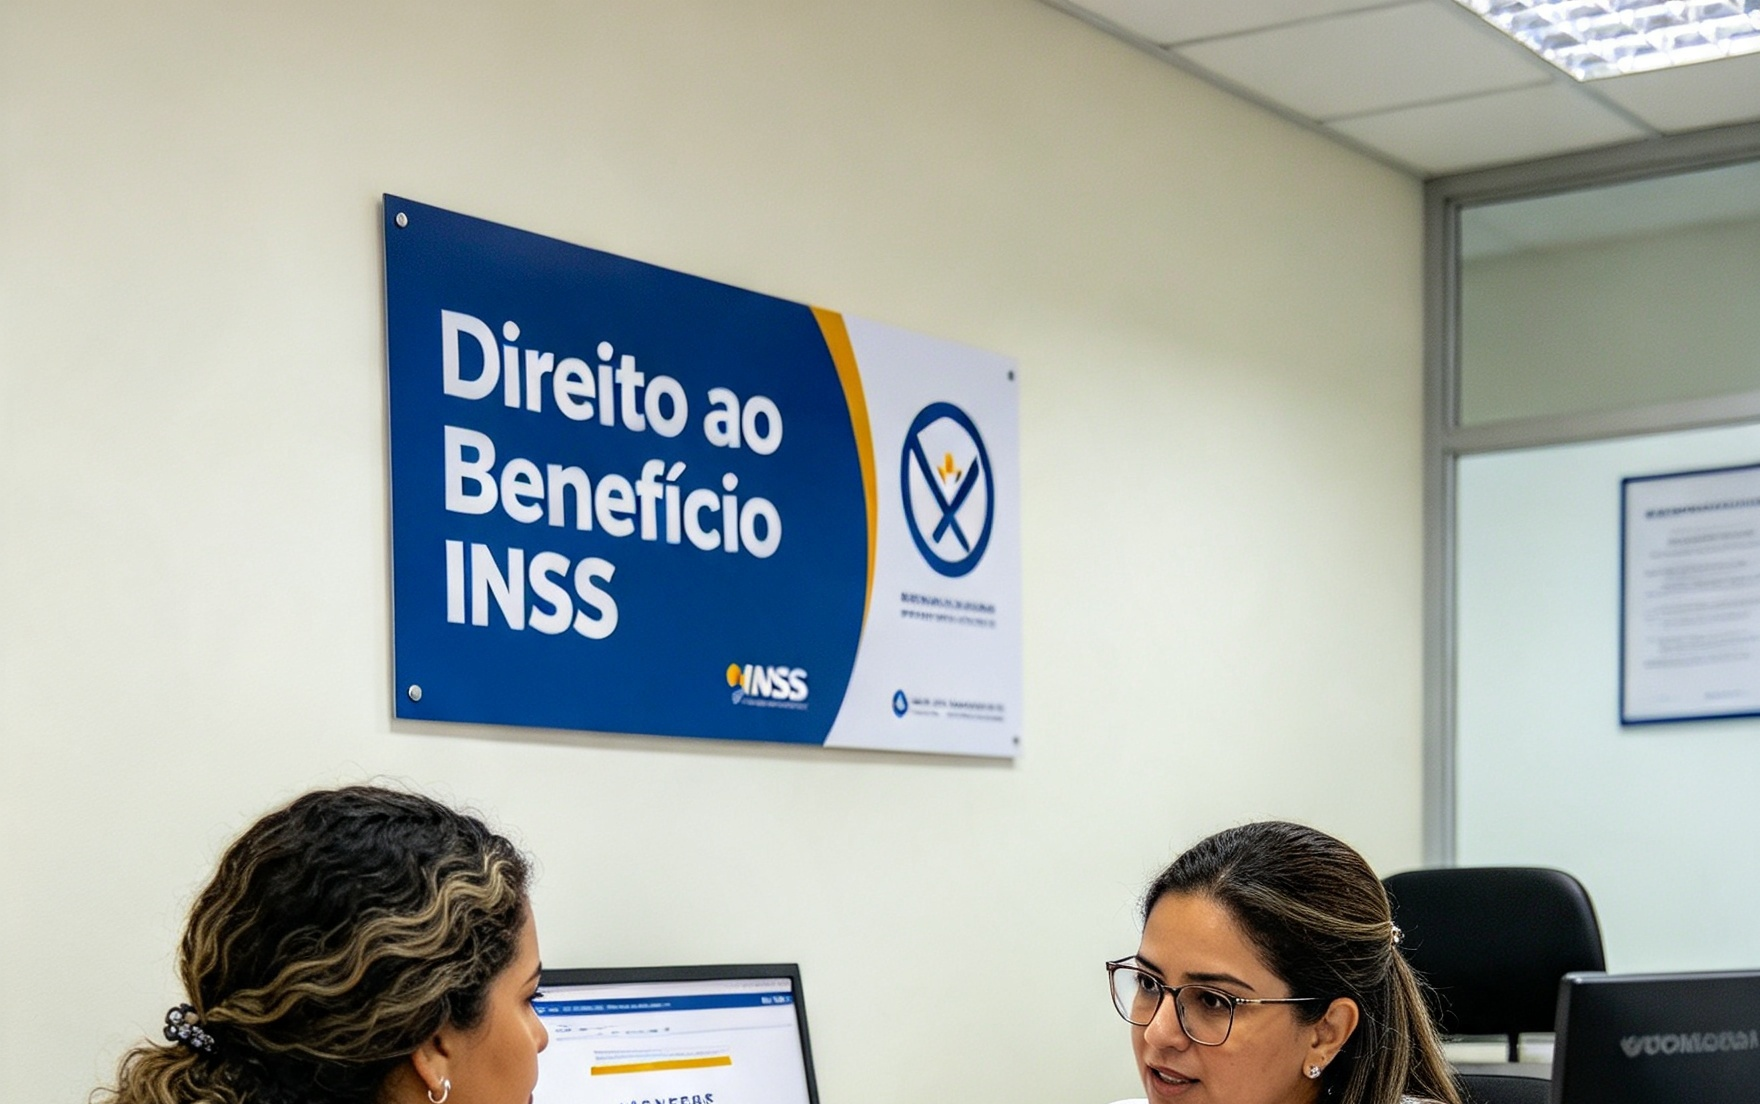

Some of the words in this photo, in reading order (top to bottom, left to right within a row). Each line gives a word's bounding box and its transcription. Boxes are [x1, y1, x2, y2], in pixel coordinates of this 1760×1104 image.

[441, 309, 688, 438] Direito
[703, 388, 783, 455] ao
[444, 425, 782, 558] Benefício
[445, 539, 619, 640] INSS
[742, 664, 808, 701] INSS
